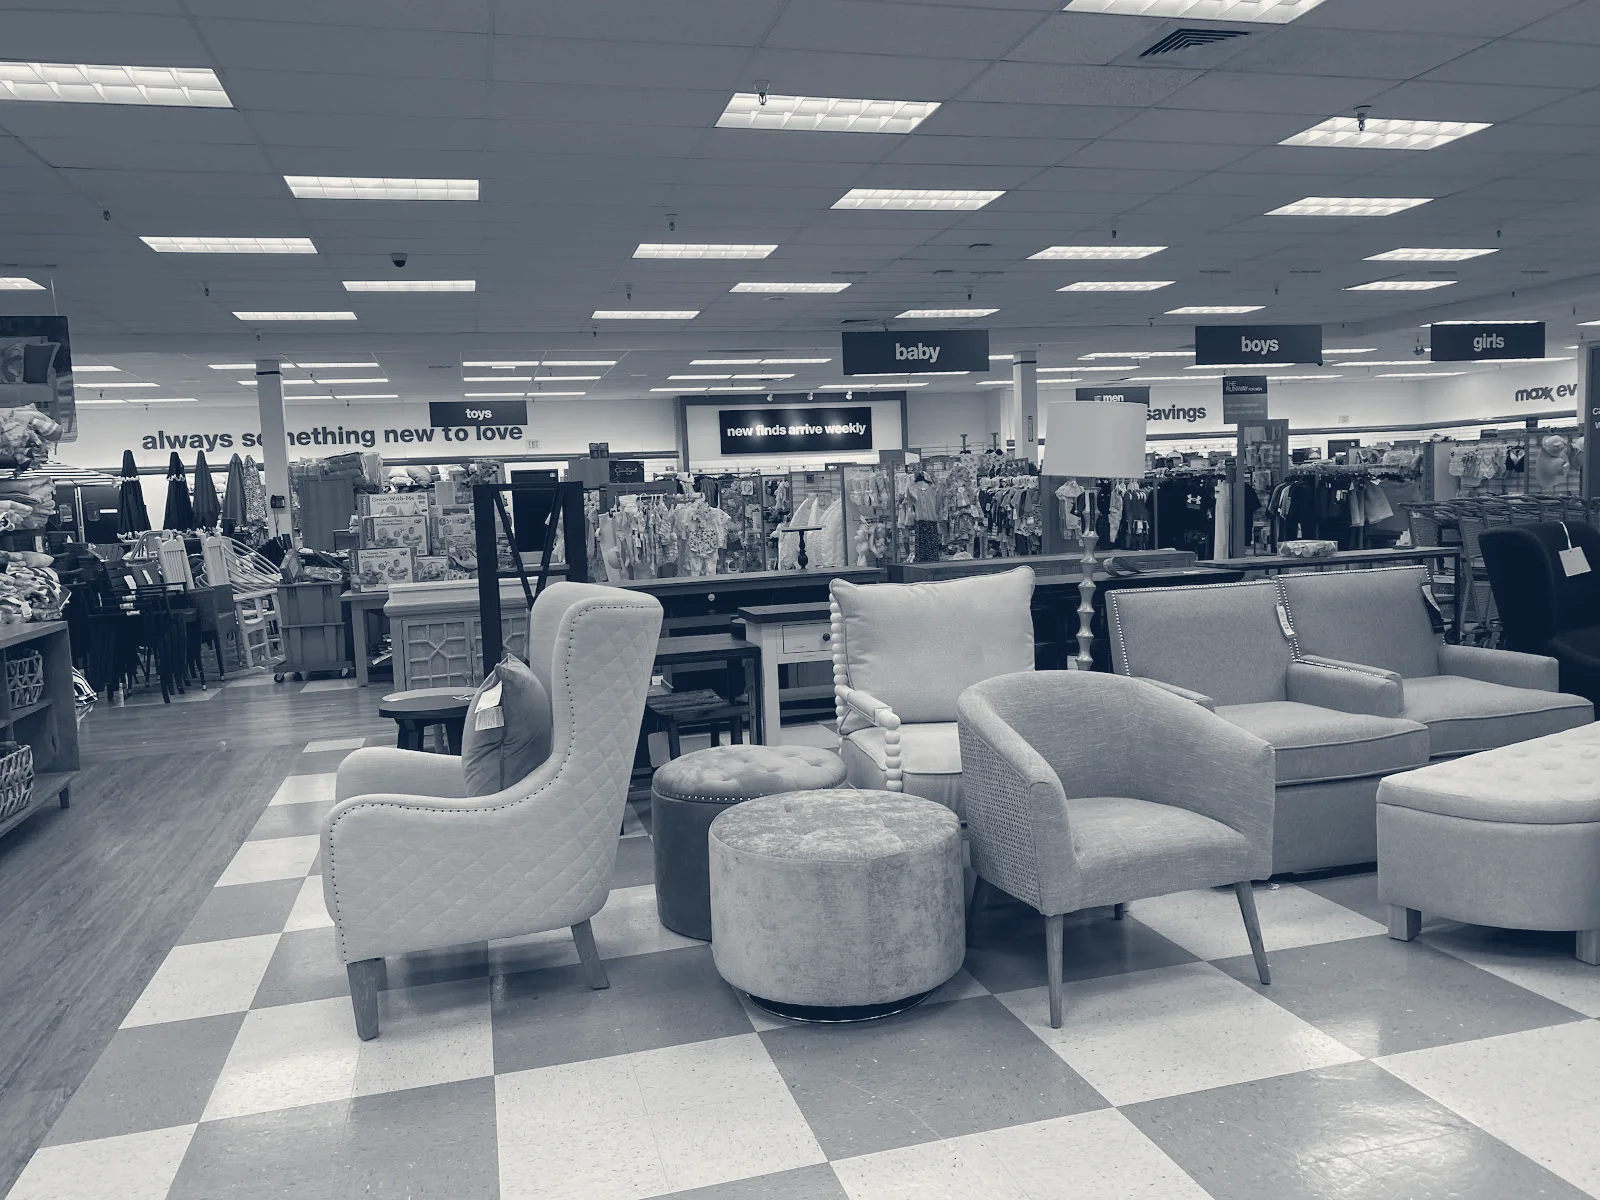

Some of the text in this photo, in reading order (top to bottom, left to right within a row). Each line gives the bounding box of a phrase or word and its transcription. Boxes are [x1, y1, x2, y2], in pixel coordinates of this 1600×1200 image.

[1241, 336, 1280, 355] boys
[1473, 333, 1505, 351] girls
[895, 343, 941, 364] baby
[1103, 394, 1124, 402] men
[465, 408, 493, 420] toys
[727, 422, 867, 437] new finds arrive weekly
[142, 430, 234, 452] always
[384, 428, 434, 442] new
[442, 427, 469, 442] to
[476, 426, 523, 441] love
